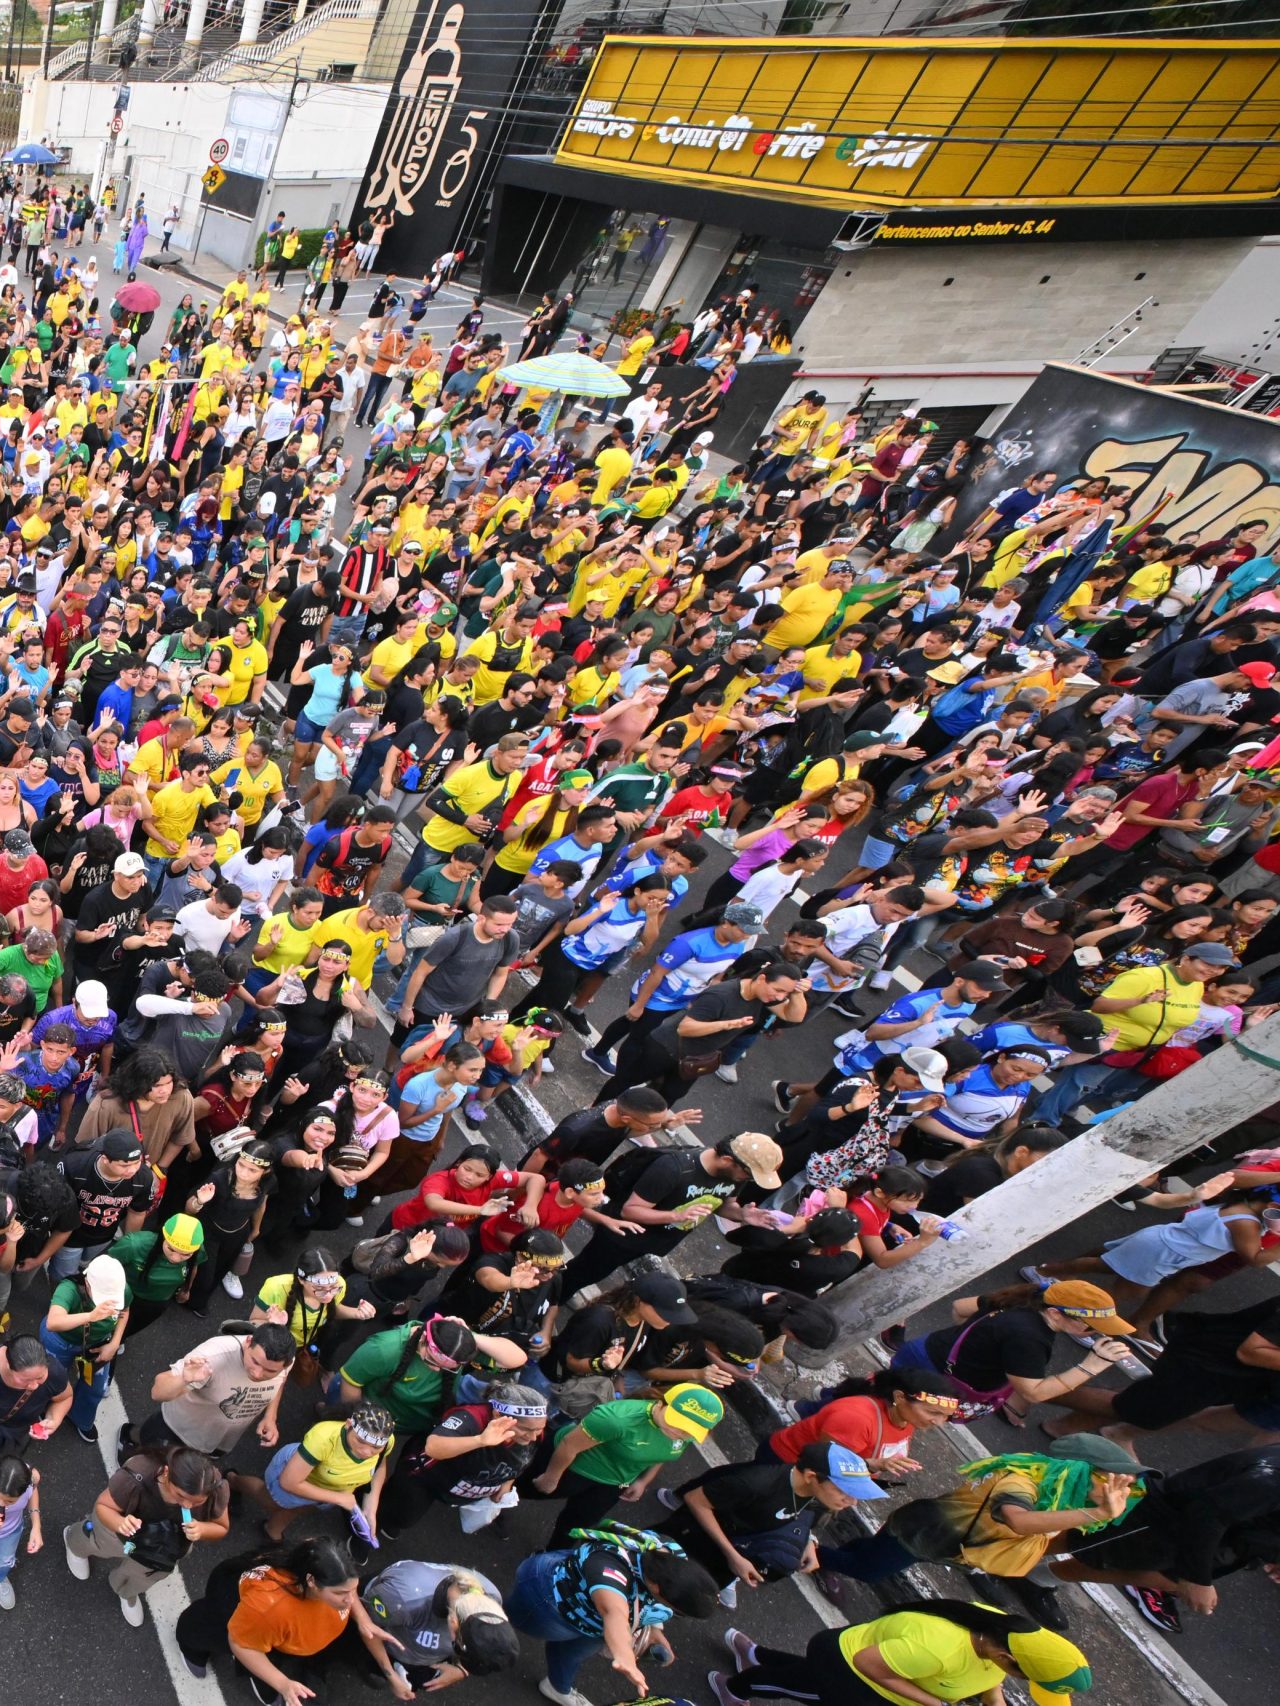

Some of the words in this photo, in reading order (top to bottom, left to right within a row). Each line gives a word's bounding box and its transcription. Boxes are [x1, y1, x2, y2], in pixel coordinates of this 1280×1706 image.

[582, 99, 613, 115] GRUPO
[573, 110, 638, 139] EMOPS
[213, 144, 227, 156] 40
[875, 224, 955, 240] Pertencemos
[954, 225, 971, 237] ao
[970, 221, 1016, 236] Senhor
[1036, 218, 1056, 234] 44
[535, 857, 550, 870] 12
[662, 952, 674, 963] 12
[915, 1391, 959, 1409] Jesu
[683, 1397, 719, 1421] Brasil
